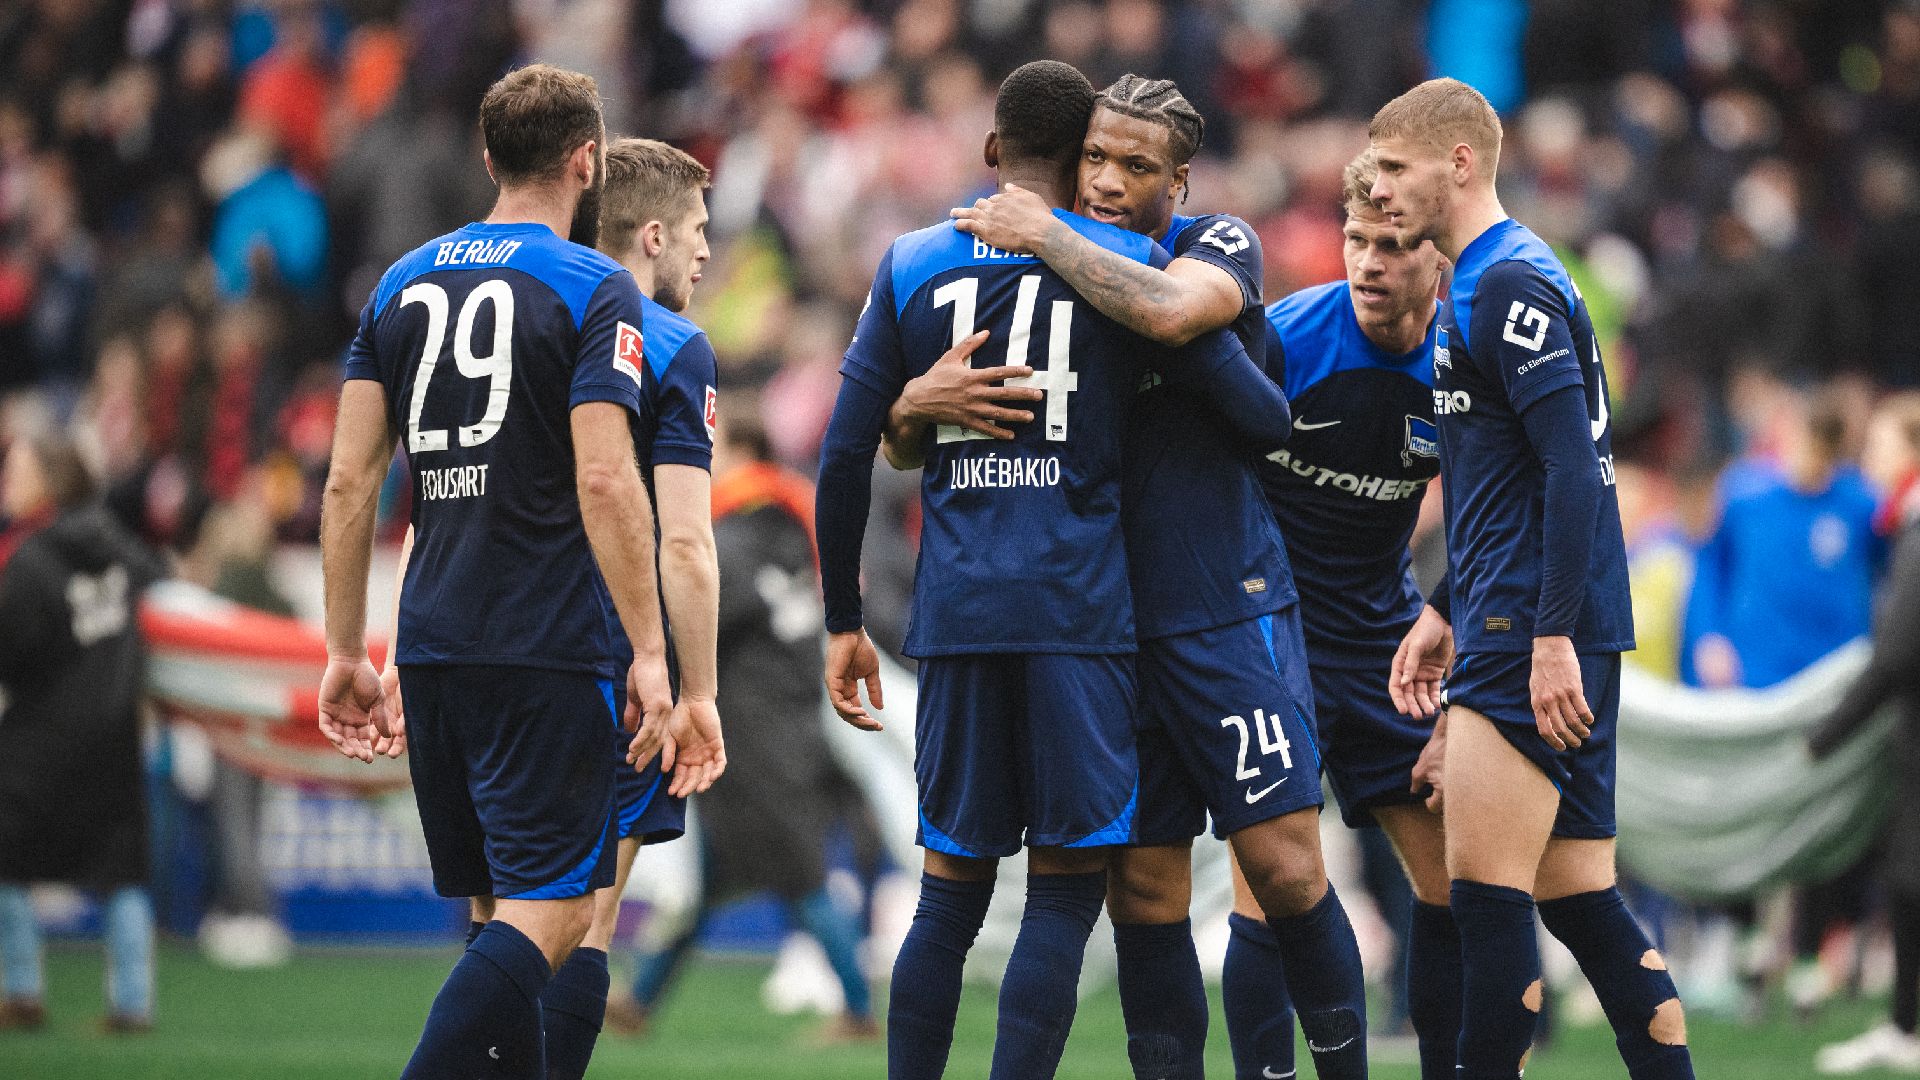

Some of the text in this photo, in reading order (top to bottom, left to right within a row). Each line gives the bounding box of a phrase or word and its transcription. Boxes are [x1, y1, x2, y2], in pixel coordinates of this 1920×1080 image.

[432, 240, 522, 266] BERLIN
[400, 279, 515, 454] 29
[934, 275, 1078, 444] 14
[1527, 348, 1570, 369] Elementum
[421, 464, 489, 500] TOUSART
[950, 452, 1060, 490] LUKÉBAKIO
[1266, 449, 1428, 501] AUTOHER
[1220, 708, 1293, 781] 24
